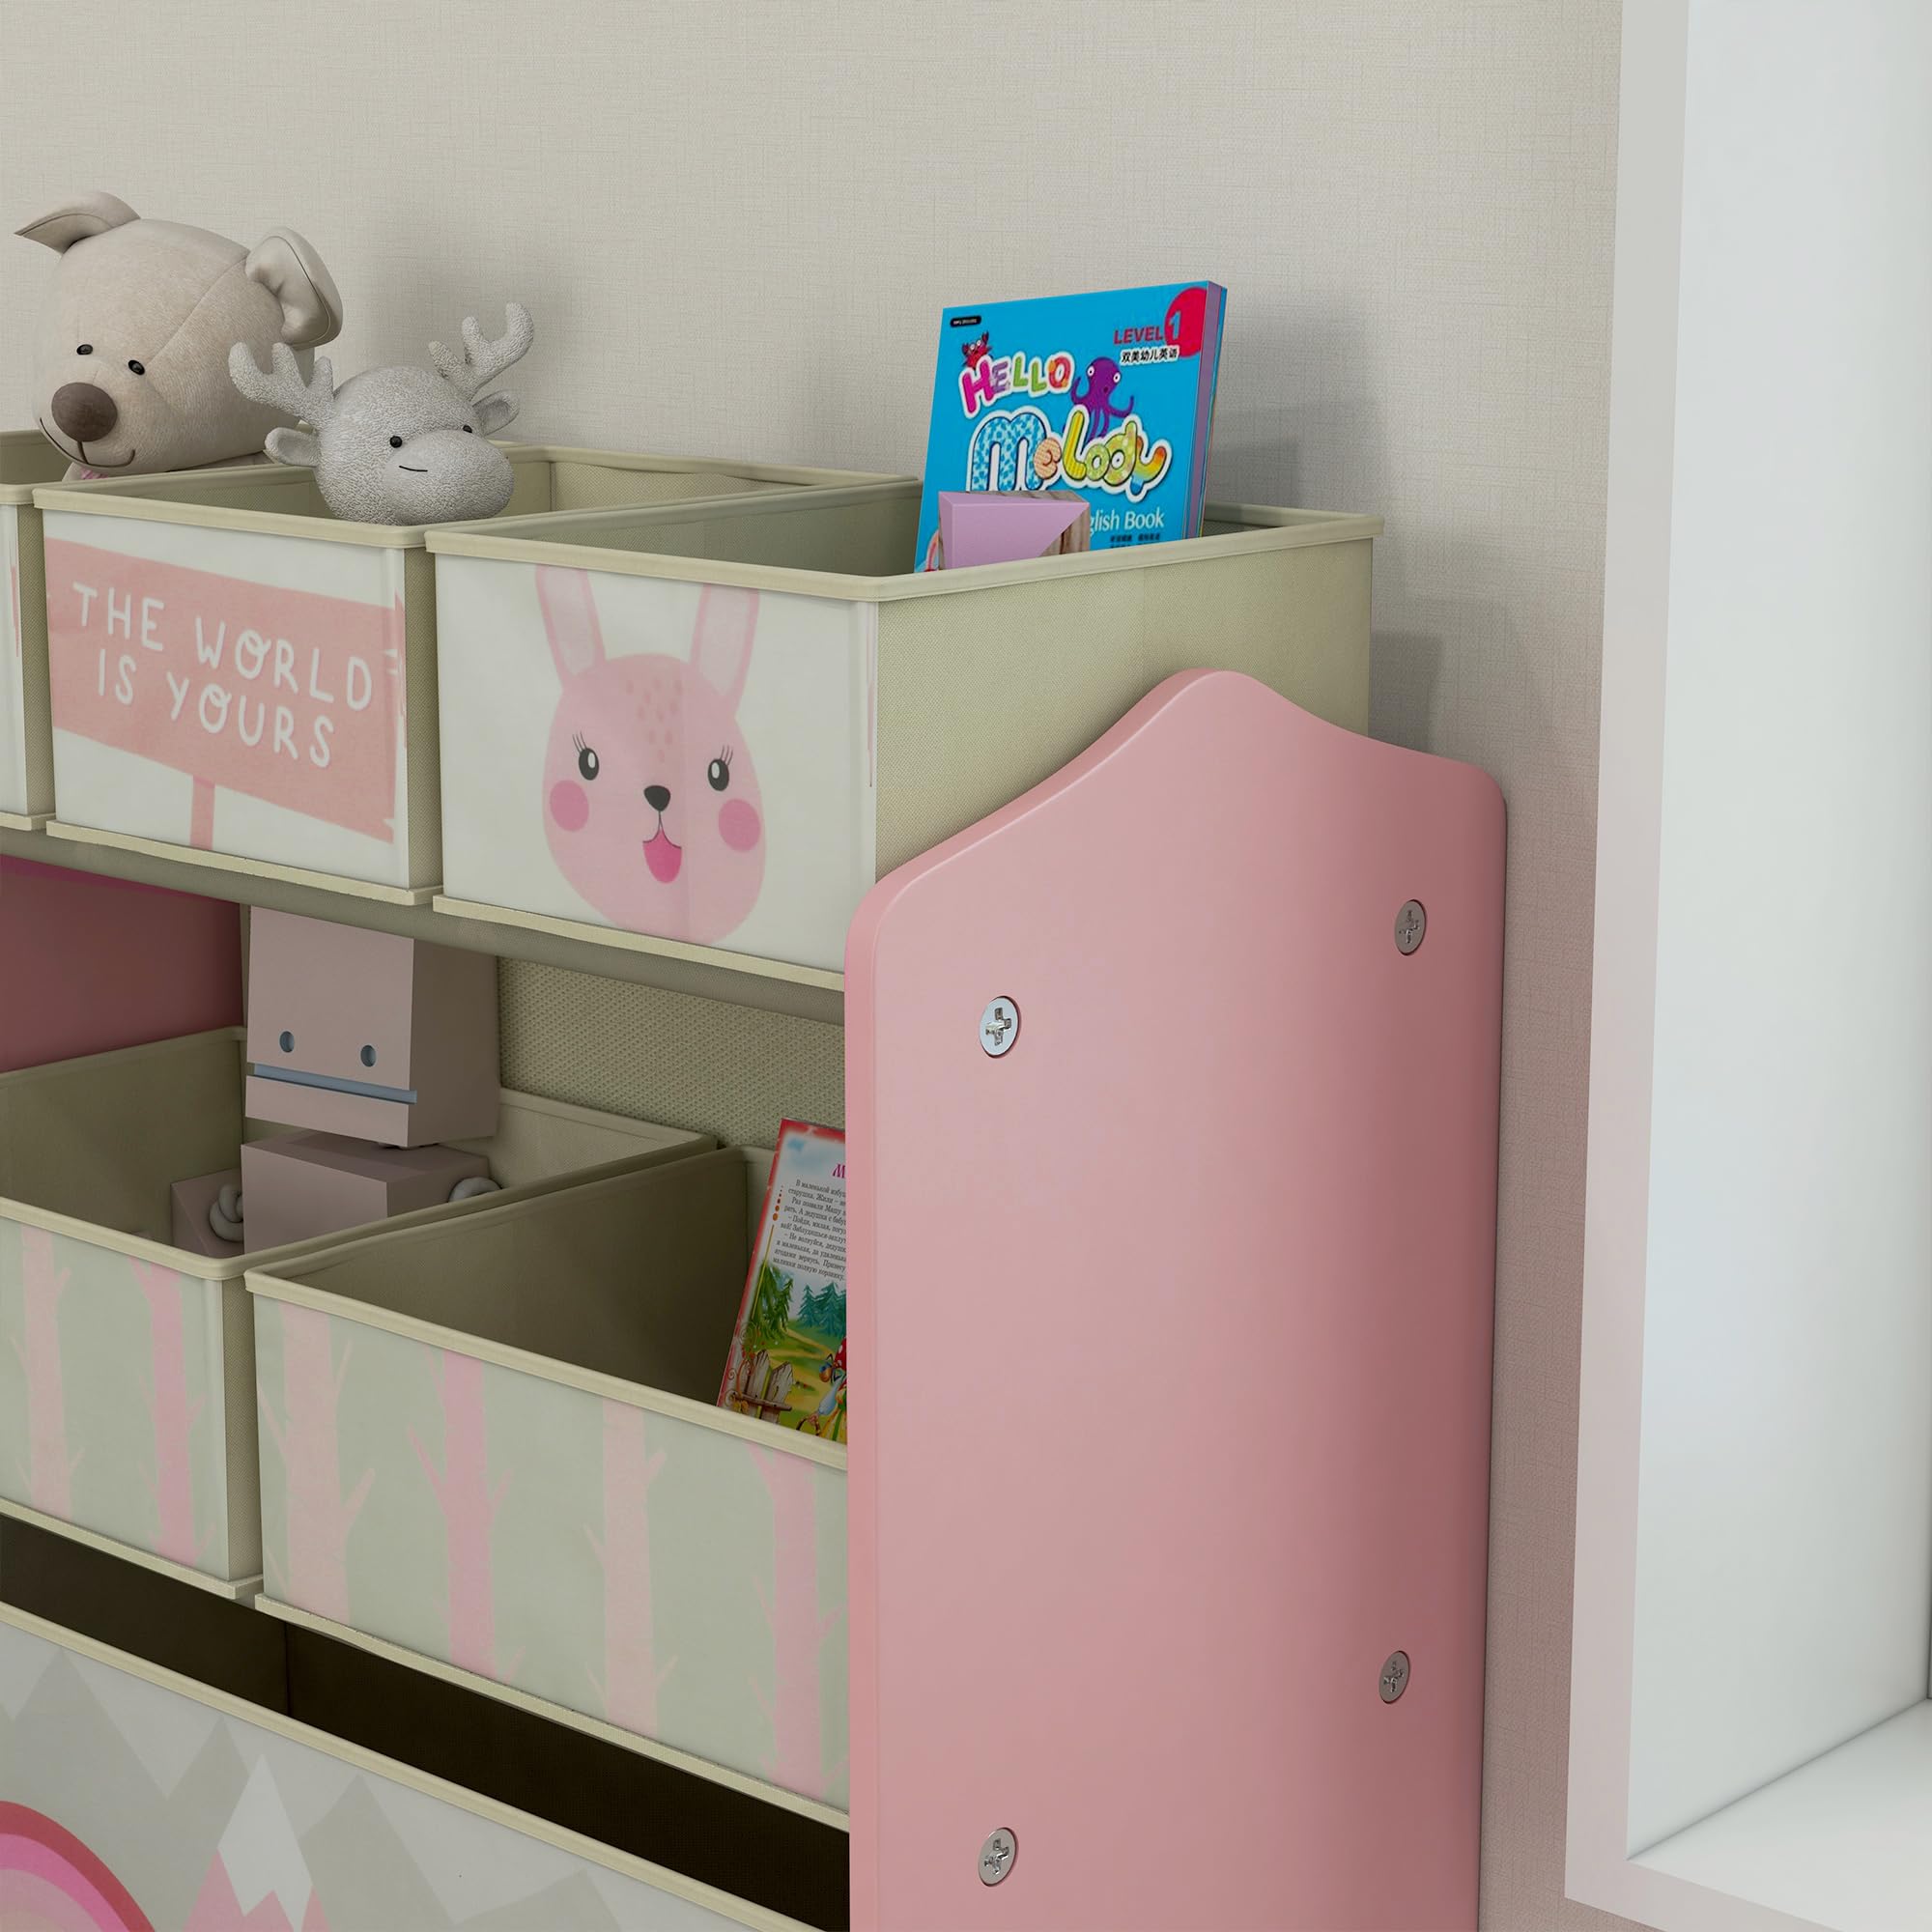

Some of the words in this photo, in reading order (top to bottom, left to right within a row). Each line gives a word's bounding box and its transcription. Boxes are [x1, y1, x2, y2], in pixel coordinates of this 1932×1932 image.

[1113, 326, 1163, 344] LEVEL
[1169, 309, 1181, 340] 1
[1122, 348, 1178, 362] 双美幼儿英语
[960, 354, 1073, 415] HELLO
[1124, 507, 1164, 529] Book
[72, 582, 165, 651] THE
[195, 615, 372, 710] WORLD
[98, 648, 136, 705] IS
[167, 671, 334, 768] YOURS
